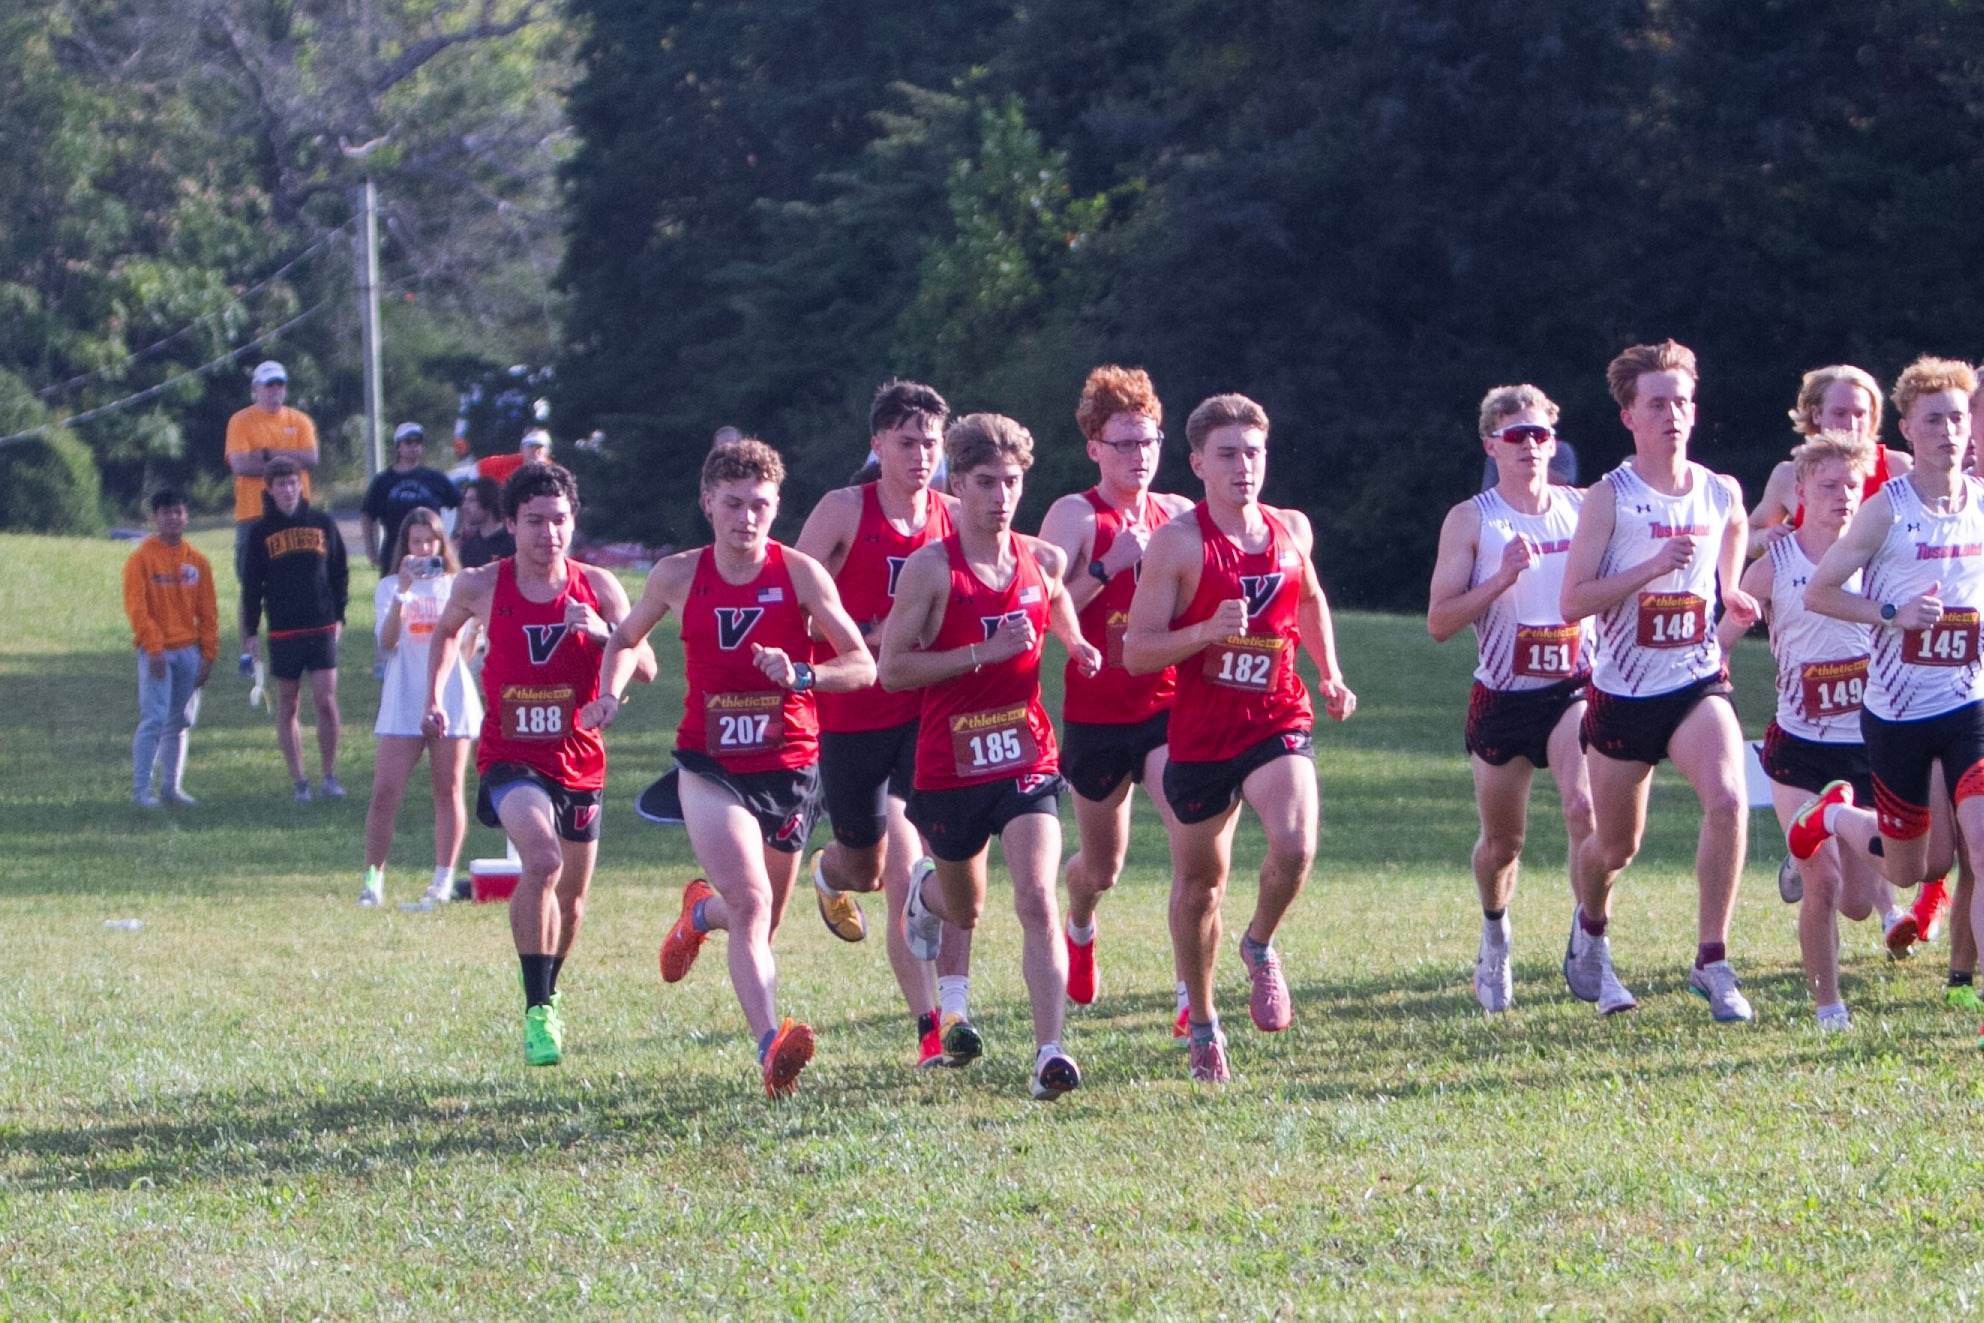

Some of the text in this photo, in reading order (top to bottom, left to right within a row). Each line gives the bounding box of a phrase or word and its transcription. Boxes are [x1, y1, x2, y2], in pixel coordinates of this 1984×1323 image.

[264, 527, 326, 559] TENNESSEE
[714, 606, 765, 650] V
[1652, 611, 1696, 641] 148
[522, 623, 568, 664] V
[1528, 644, 1570, 672] 151
[1918, 629, 1968, 659] 145
[1218, 651, 1271, 685] 182
[1817, 677, 1863, 709] 149
[516, 705, 562, 733] 188
[719, 714, 770, 746] 207
[970, 728, 1021, 766] 185
